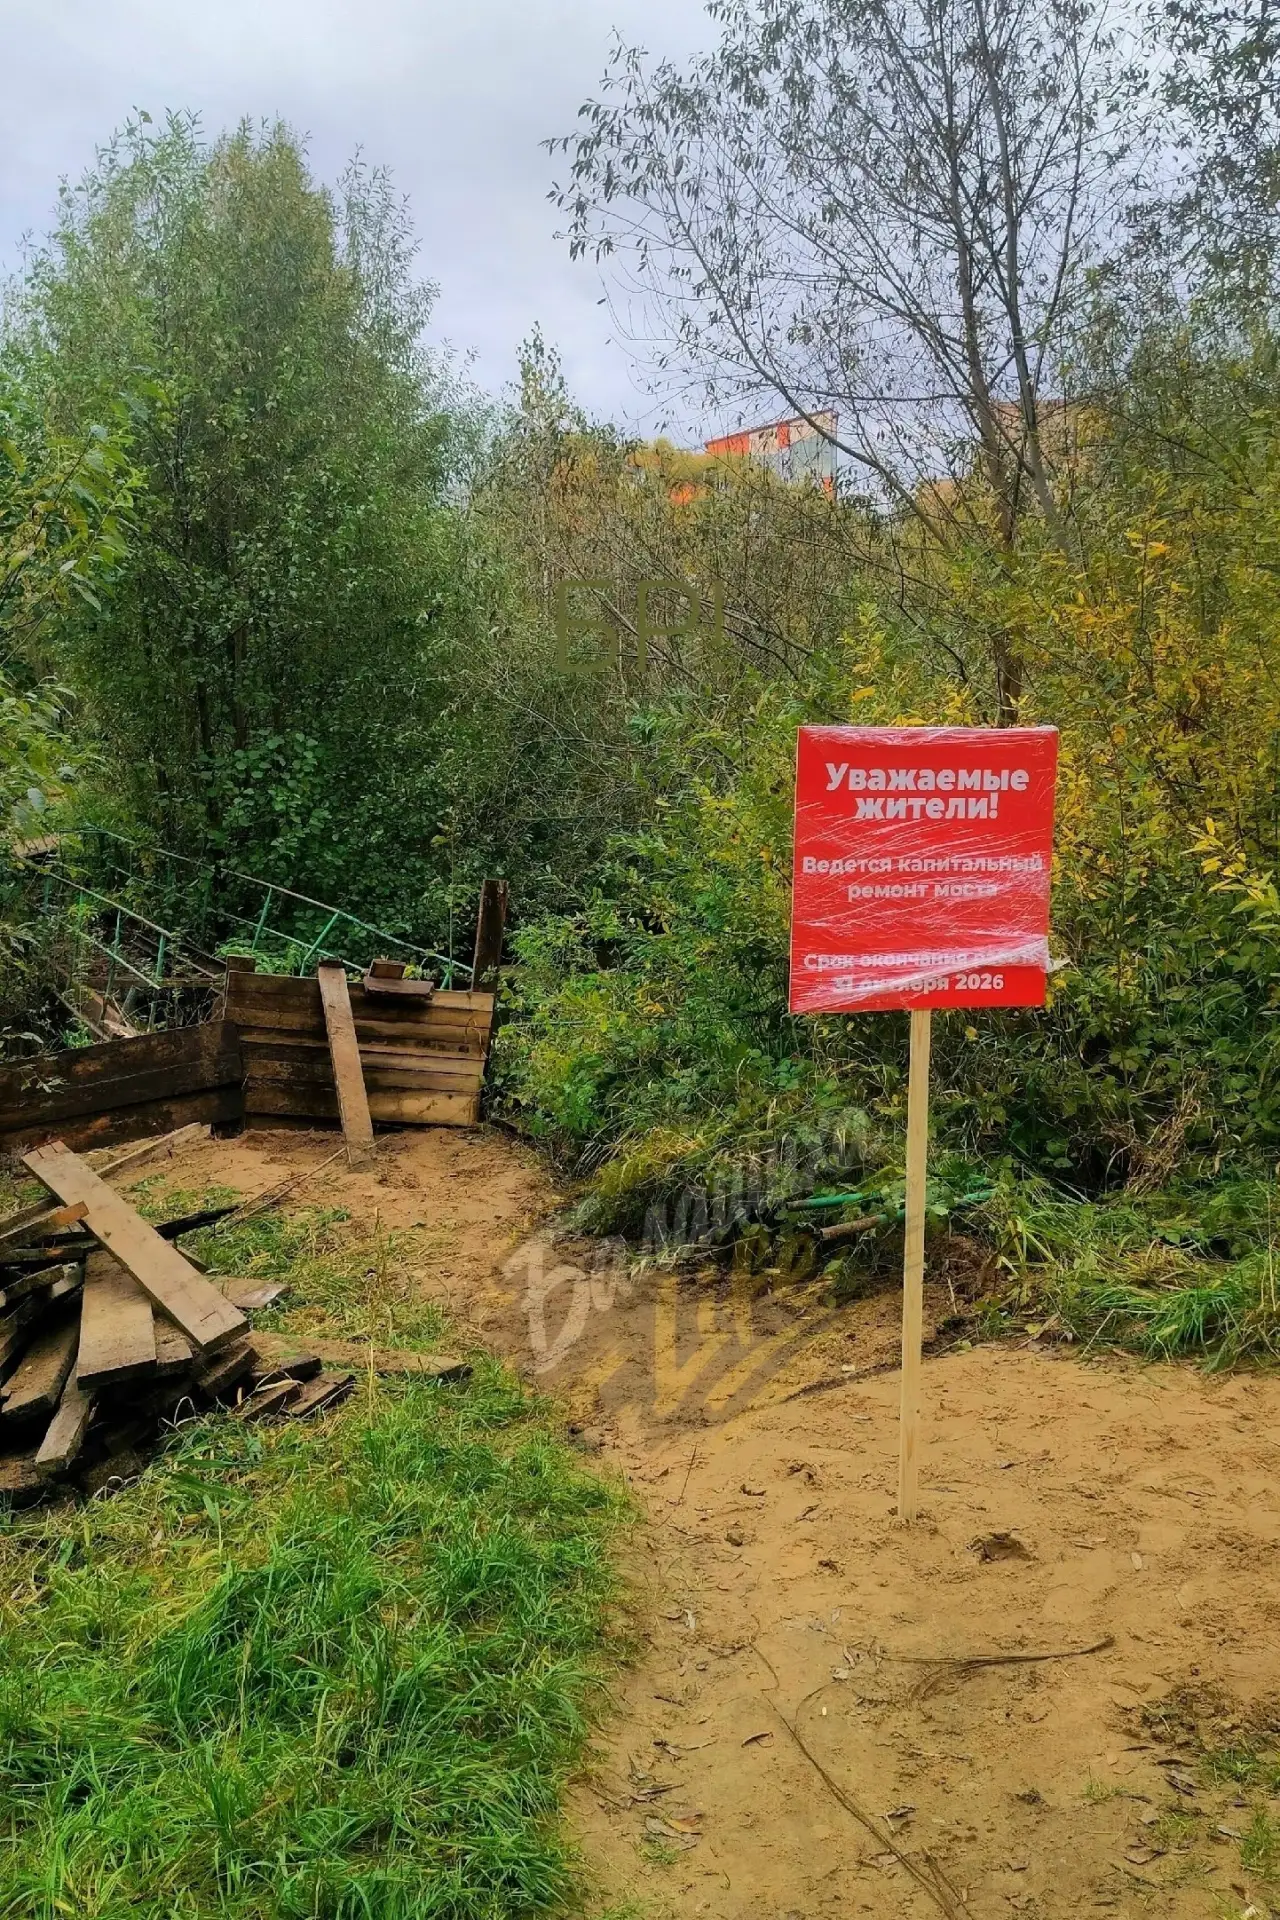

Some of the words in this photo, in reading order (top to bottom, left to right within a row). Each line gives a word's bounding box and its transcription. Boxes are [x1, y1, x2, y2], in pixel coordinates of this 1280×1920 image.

[825, 762, 1030, 791] Уважаемые
[854, 792, 999, 819] жители!
[802, 856, 892, 875] Ведется
[899, 853, 1043, 873] капитальный
[848, 883, 928, 902] ремонт
[934, 883, 998, 898] моста
[954, 973, 1005, 991] 2026
